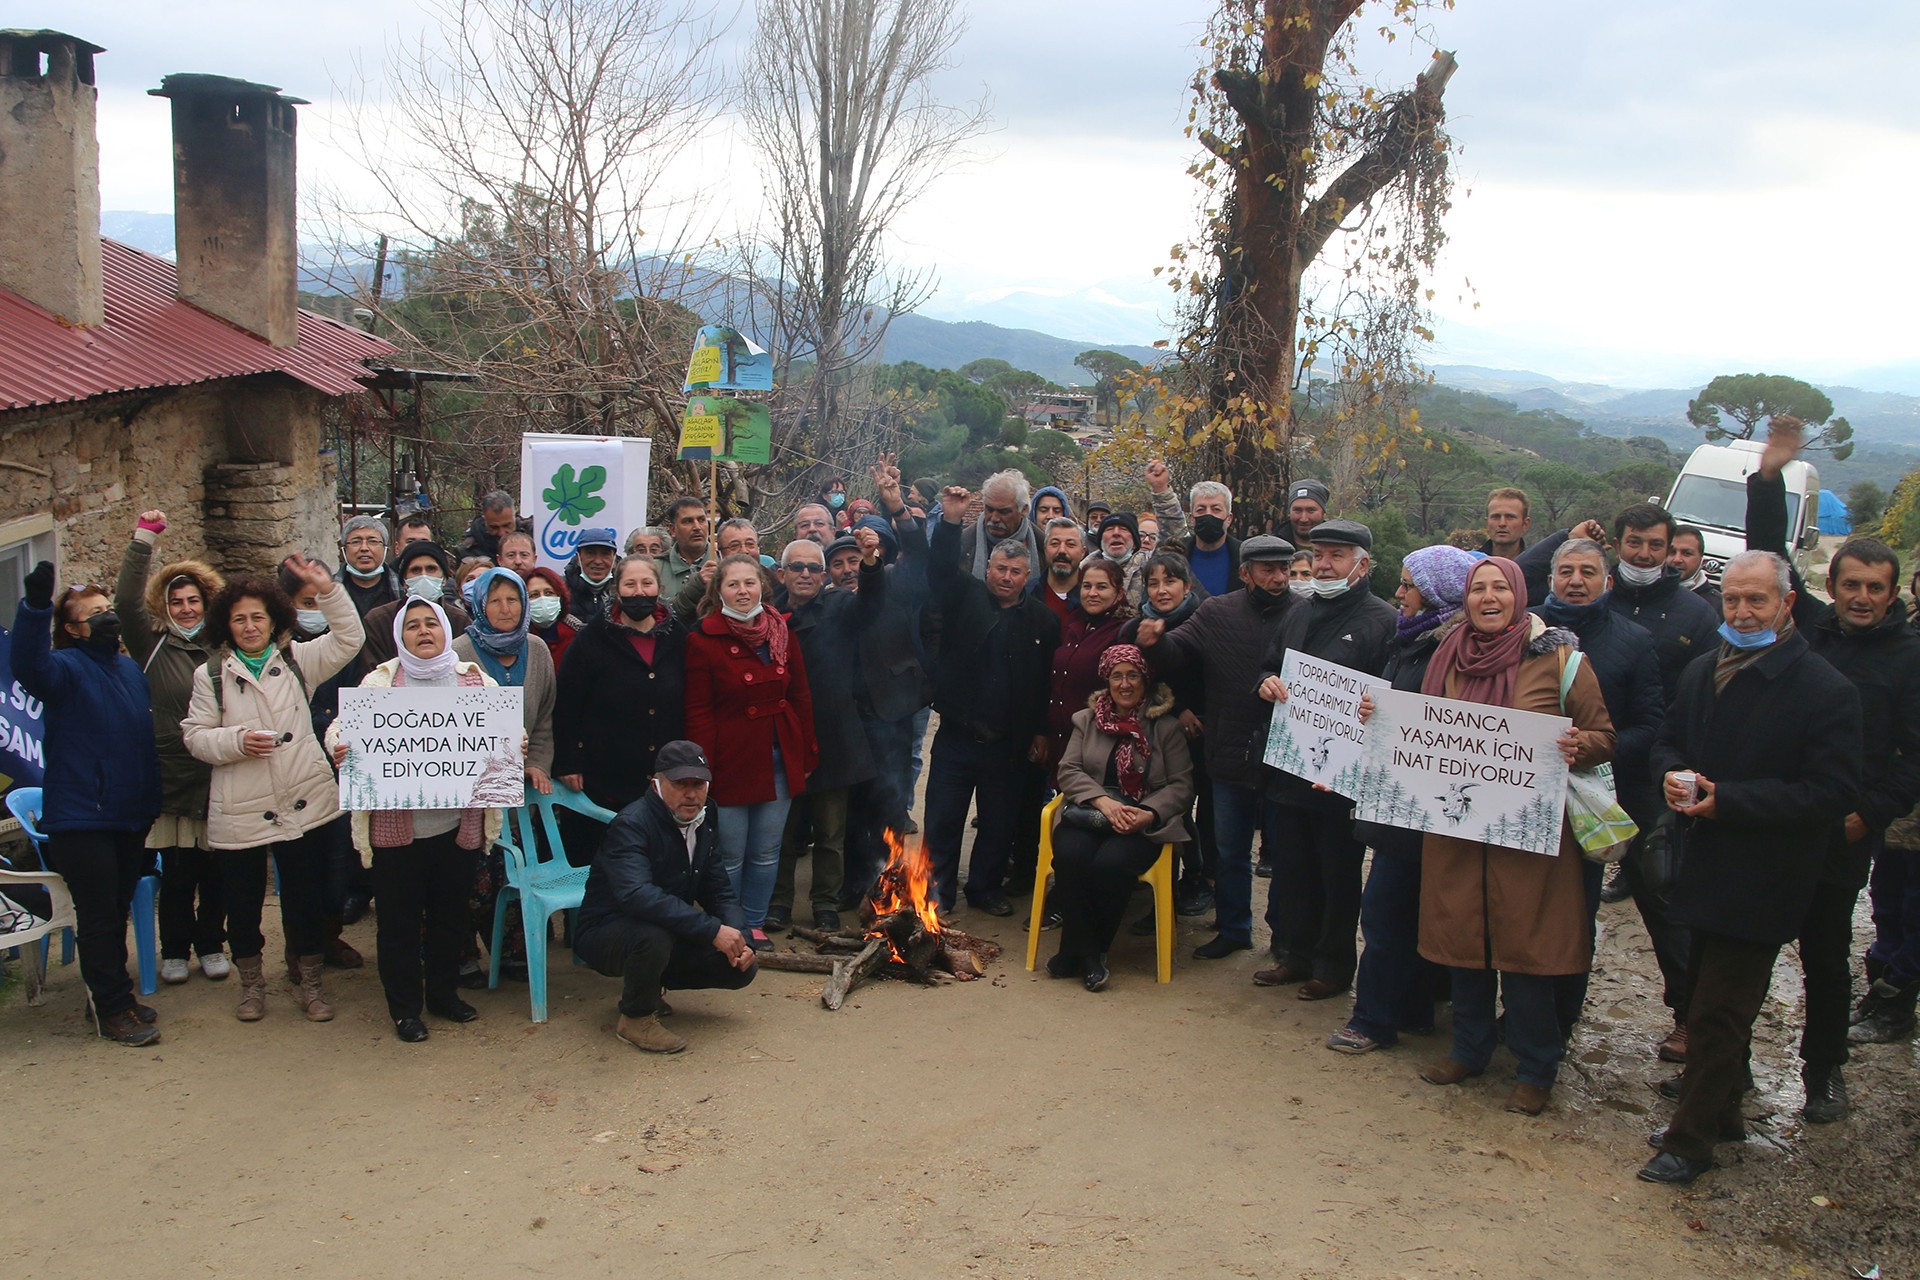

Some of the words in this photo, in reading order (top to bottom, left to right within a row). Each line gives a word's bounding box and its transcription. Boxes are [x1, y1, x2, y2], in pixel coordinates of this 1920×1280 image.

[1298, 661, 1357, 695] TOPRAĞIMIZ
[1286, 681, 1352, 717] AĞAÇLARIMIZ
[373, 709, 458, 729] DOĞADA
[463, 712, 485, 727] VE
[1289, 701, 1312, 724] İNAT
[1312, 711, 1365, 745] EDİYORUZ
[1424, 702, 1510, 734] İNSANCA
[361, 737, 452, 756] YAŞAMDA
[457, 733, 498, 752] İNAT
[1400, 726, 1487, 756] YAŞAMAK
[1493, 738, 1533, 763] İÇİN
[383, 759, 478, 778] EDİYORUZ
[1393, 746, 1434, 771] İNAT
[1439, 758, 1536, 789] EDİYORUZ
